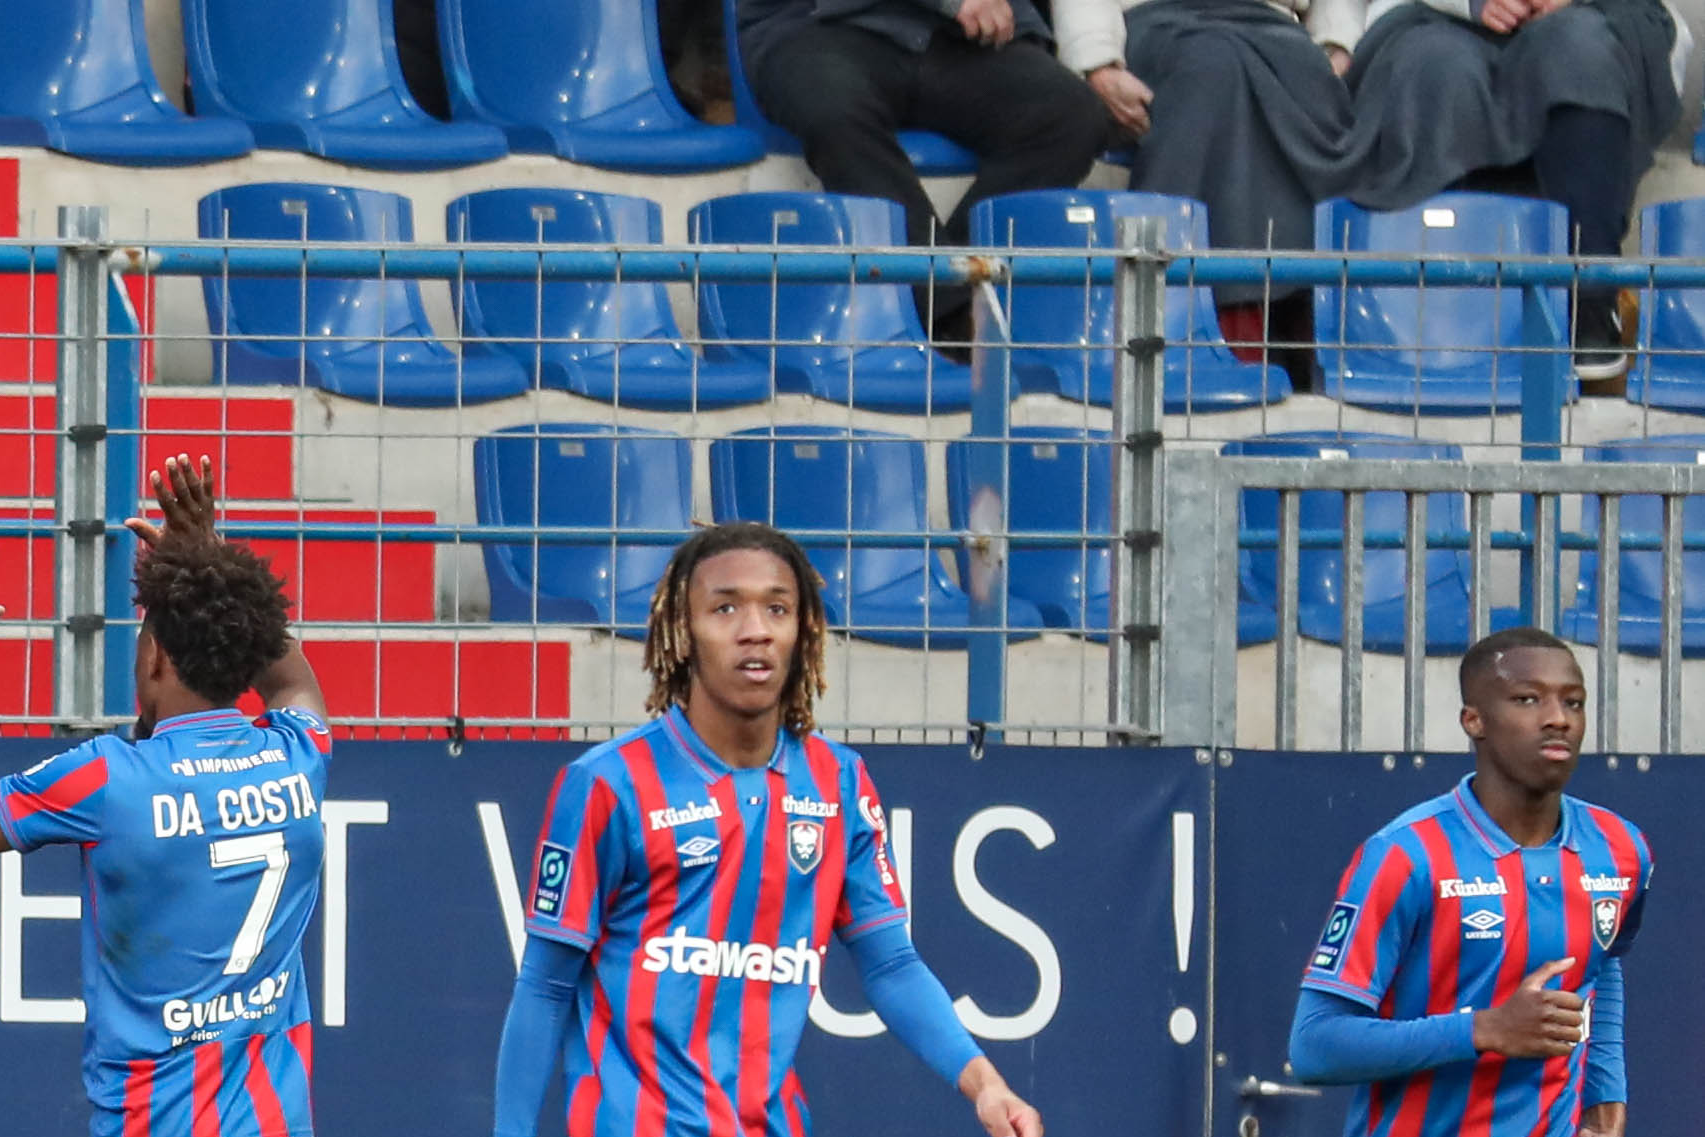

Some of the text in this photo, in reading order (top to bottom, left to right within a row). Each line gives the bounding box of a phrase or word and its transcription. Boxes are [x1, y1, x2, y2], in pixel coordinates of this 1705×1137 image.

[151, 773, 317, 839] DA COSTA
[650, 797, 723, 831] Künkel
[780, 794, 840, 818] thalazur
[1439, 876, 1507, 899] Künkel
[1580, 874, 1632, 893] thalazur
[209, 831, 290, 977] 7
[1464, 929, 1503, 941] umbro
